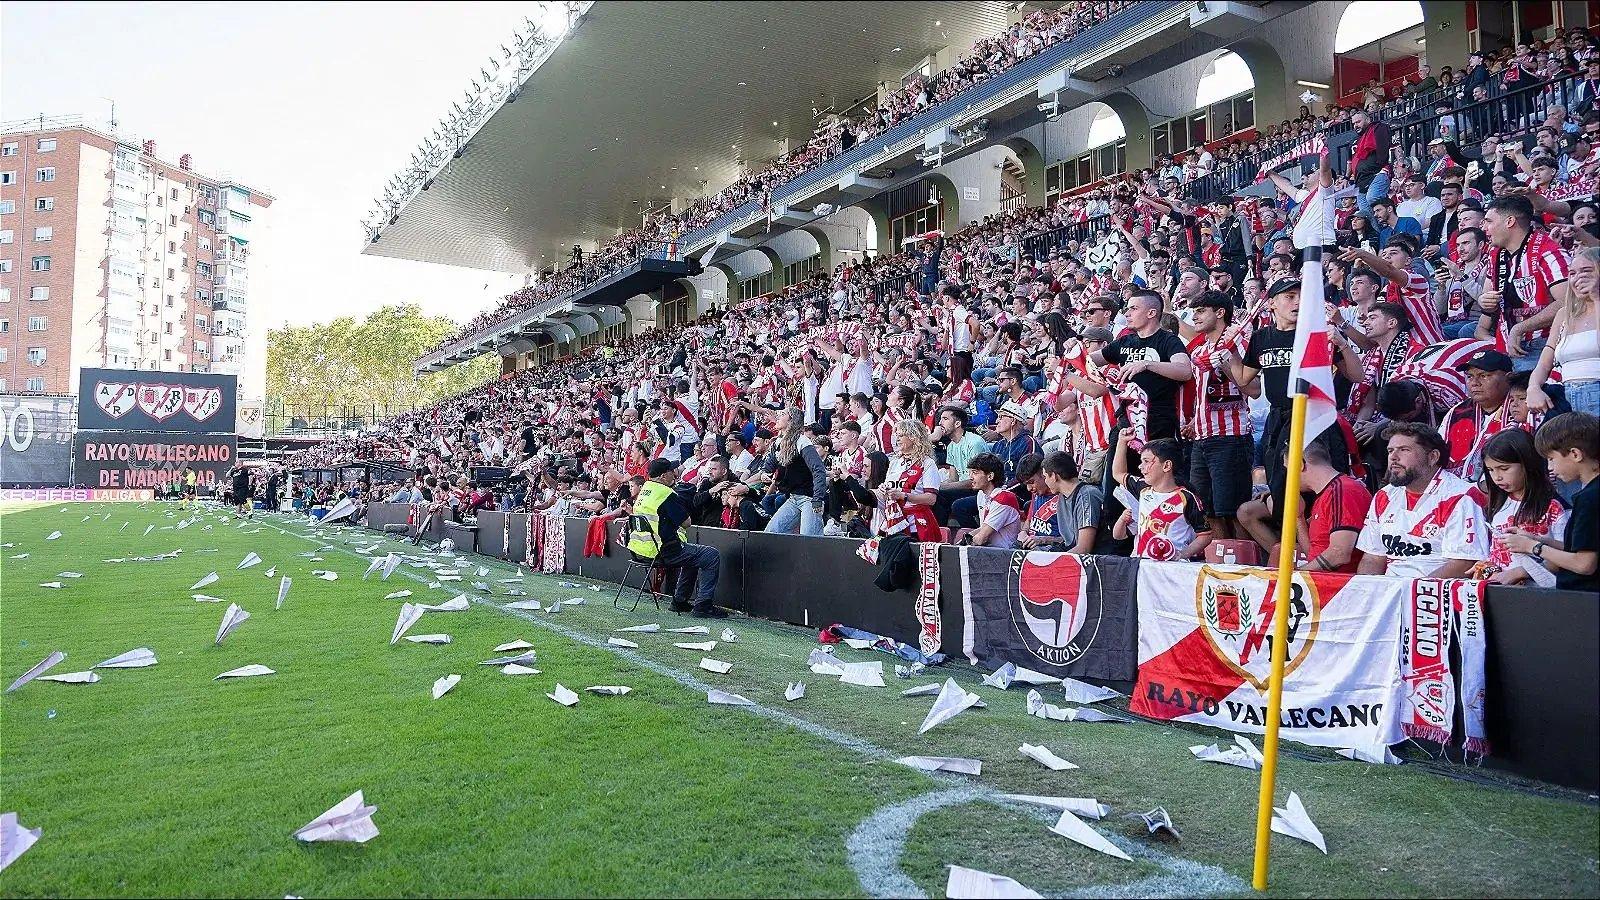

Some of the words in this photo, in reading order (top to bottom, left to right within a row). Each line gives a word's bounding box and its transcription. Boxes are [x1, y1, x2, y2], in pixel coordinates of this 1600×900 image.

[0, 406, 33, 452] 0
[85, 443, 129, 460] RAYO
[134, 444, 230, 462] VALLECANO
[93, 489, 136, 500] LALIGA
[100, 470, 119, 486] DE
[124, 470, 183, 487] MADRID
[923, 588, 935, 625] RAYO
[1416, 580, 1439, 657] ECANO
[1465, 592, 1479, 637] Nobleza
[1036, 642, 1082, 662] AKTION
[1402, 627, 1410, 666] 1924
[1148, 682, 1219, 716] RAYO
